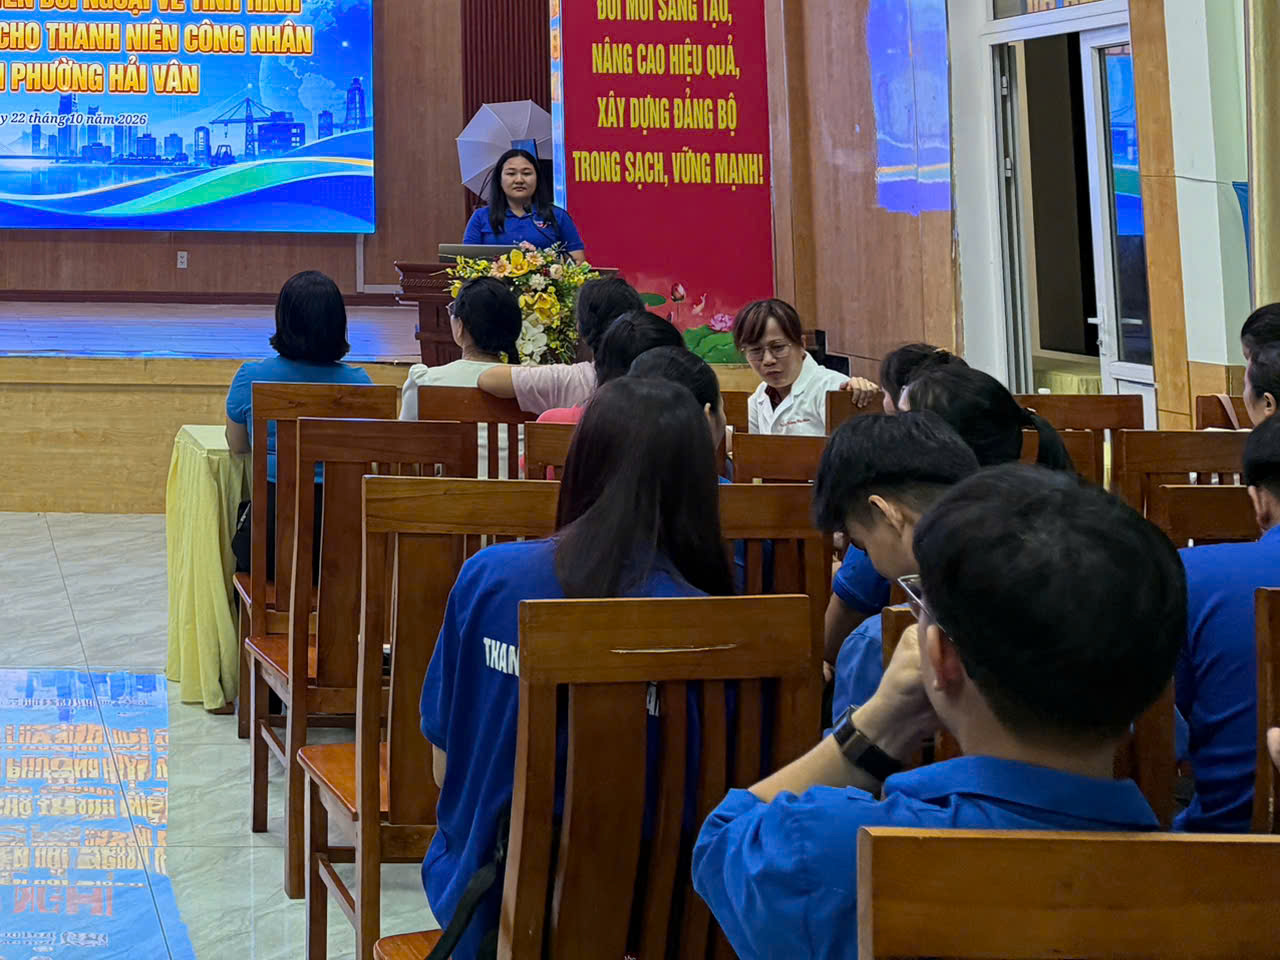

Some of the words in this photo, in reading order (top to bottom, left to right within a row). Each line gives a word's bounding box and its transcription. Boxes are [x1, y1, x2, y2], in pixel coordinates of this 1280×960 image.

[46, 22, 121, 52] THANH
[125, 19, 180, 53] NIÊN
[183, 19, 246, 54] CÔNG
[250, 19, 314, 55] NHÂN
[591, 36, 633, 75] NÂNG
[636, 43, 666, 75] CAO
[669, 38, 702, 82] HIỆU
[706, 34, 741, 80] QUẢ,
[10, 57, 104, 93] PHƯỜNG
[108, 55, 148, 94] HẢI
[152, 59, 200, 95] VÂN
[10, 112, 26, 124] 22
[29, 112, 66, 126] tháng
[69, 113, 83, 125] 10
[86, 113, 115, 125] năm
[117, 114, 147, 125] 2026
[597, 90, 626, 128] XÂY
[630, 94, 670, 135] DỰNG
[673, 87, 714, 129] ĐẢNG
[717, 92, 737, 137] BỘ
[572, 150, 621, 182] TRONG
[625, 152, 668, 190] SẠCH,
[671, 146, 712, 184] VỮNG
[715, 152, 764, 191] MẠNH!
